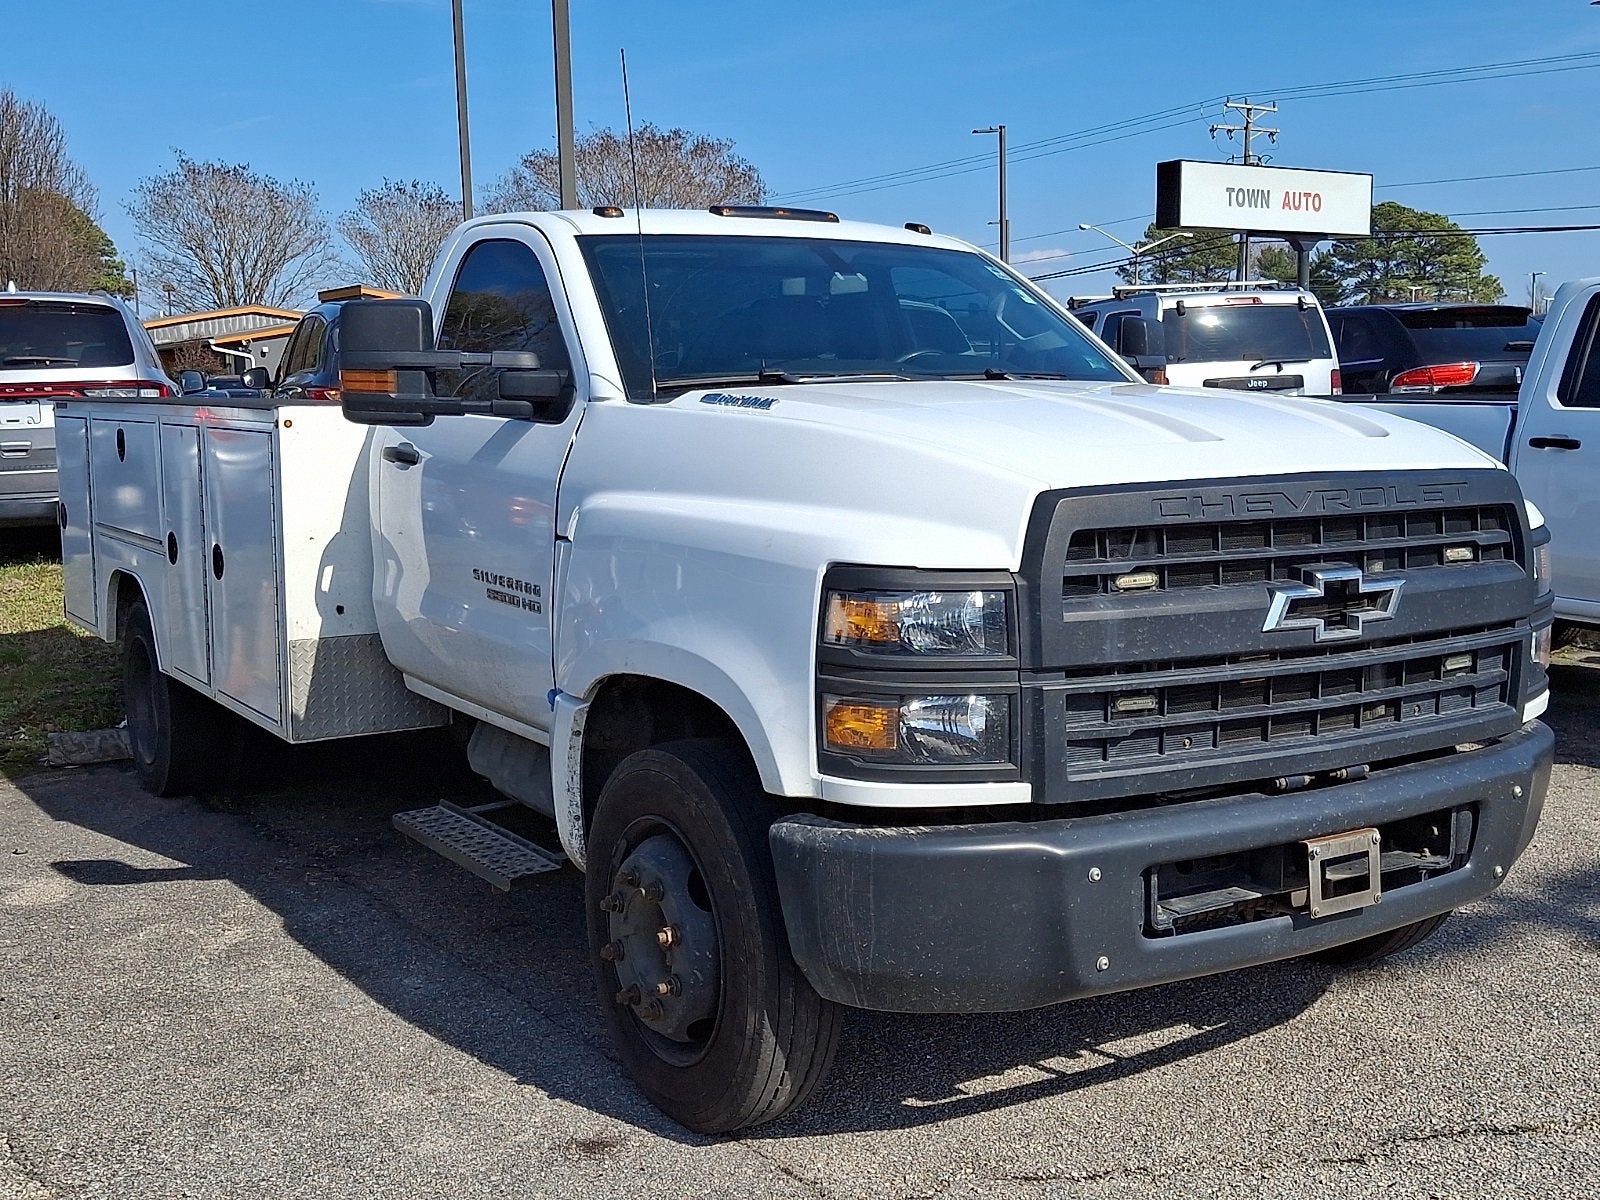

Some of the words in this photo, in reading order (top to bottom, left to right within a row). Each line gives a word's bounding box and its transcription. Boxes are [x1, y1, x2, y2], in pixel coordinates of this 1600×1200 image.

[1226, 187, 1271, 209] TOWN
[1282, 191, 1322, 212] AUTO
[1247, 379, 1268, 388] Jeep
[1150, 481, 1469, 519] CHEVROLET
[472, 568, 541, 598] SILVERADO
[521, 597, 542, 615] HD
